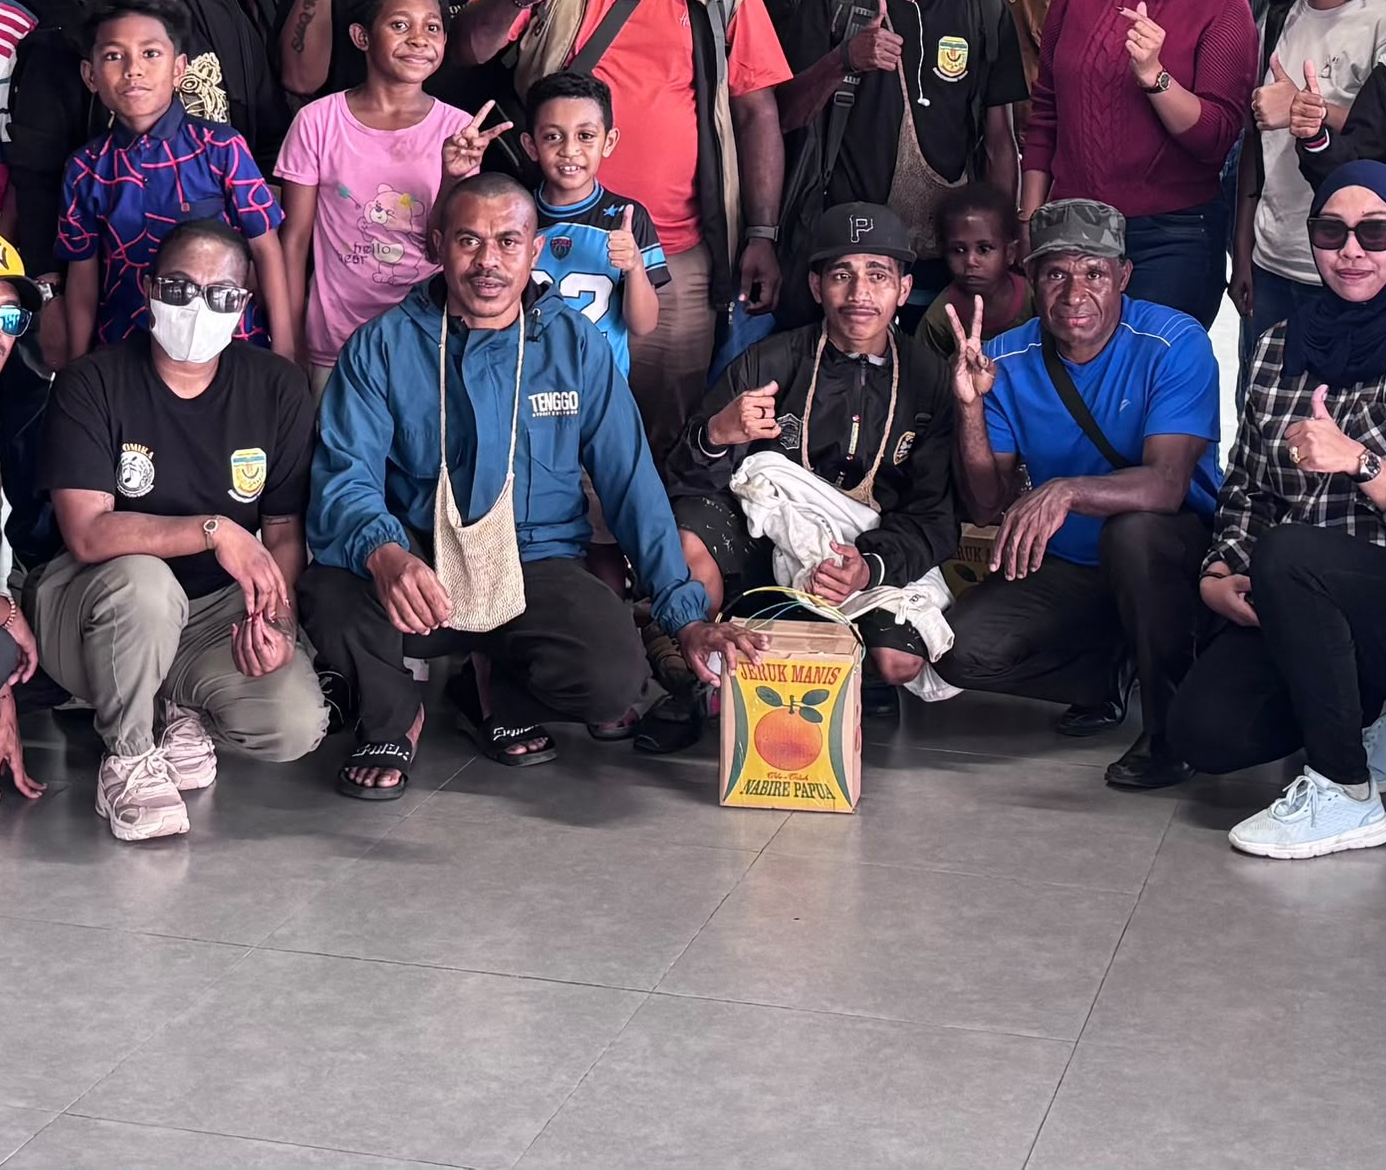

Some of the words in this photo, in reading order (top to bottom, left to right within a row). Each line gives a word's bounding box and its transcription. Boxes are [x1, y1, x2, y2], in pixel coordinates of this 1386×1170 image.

[354, 242, 391, 255] hello
[528, 390, 579, 413] TENGGO
[739, 662, 788, 683] JERUK
[791, 665, 842, 685] MANIS
[740, 779, 790, 797] NABIRE
[794, 781, 836, 800] PAPUA
